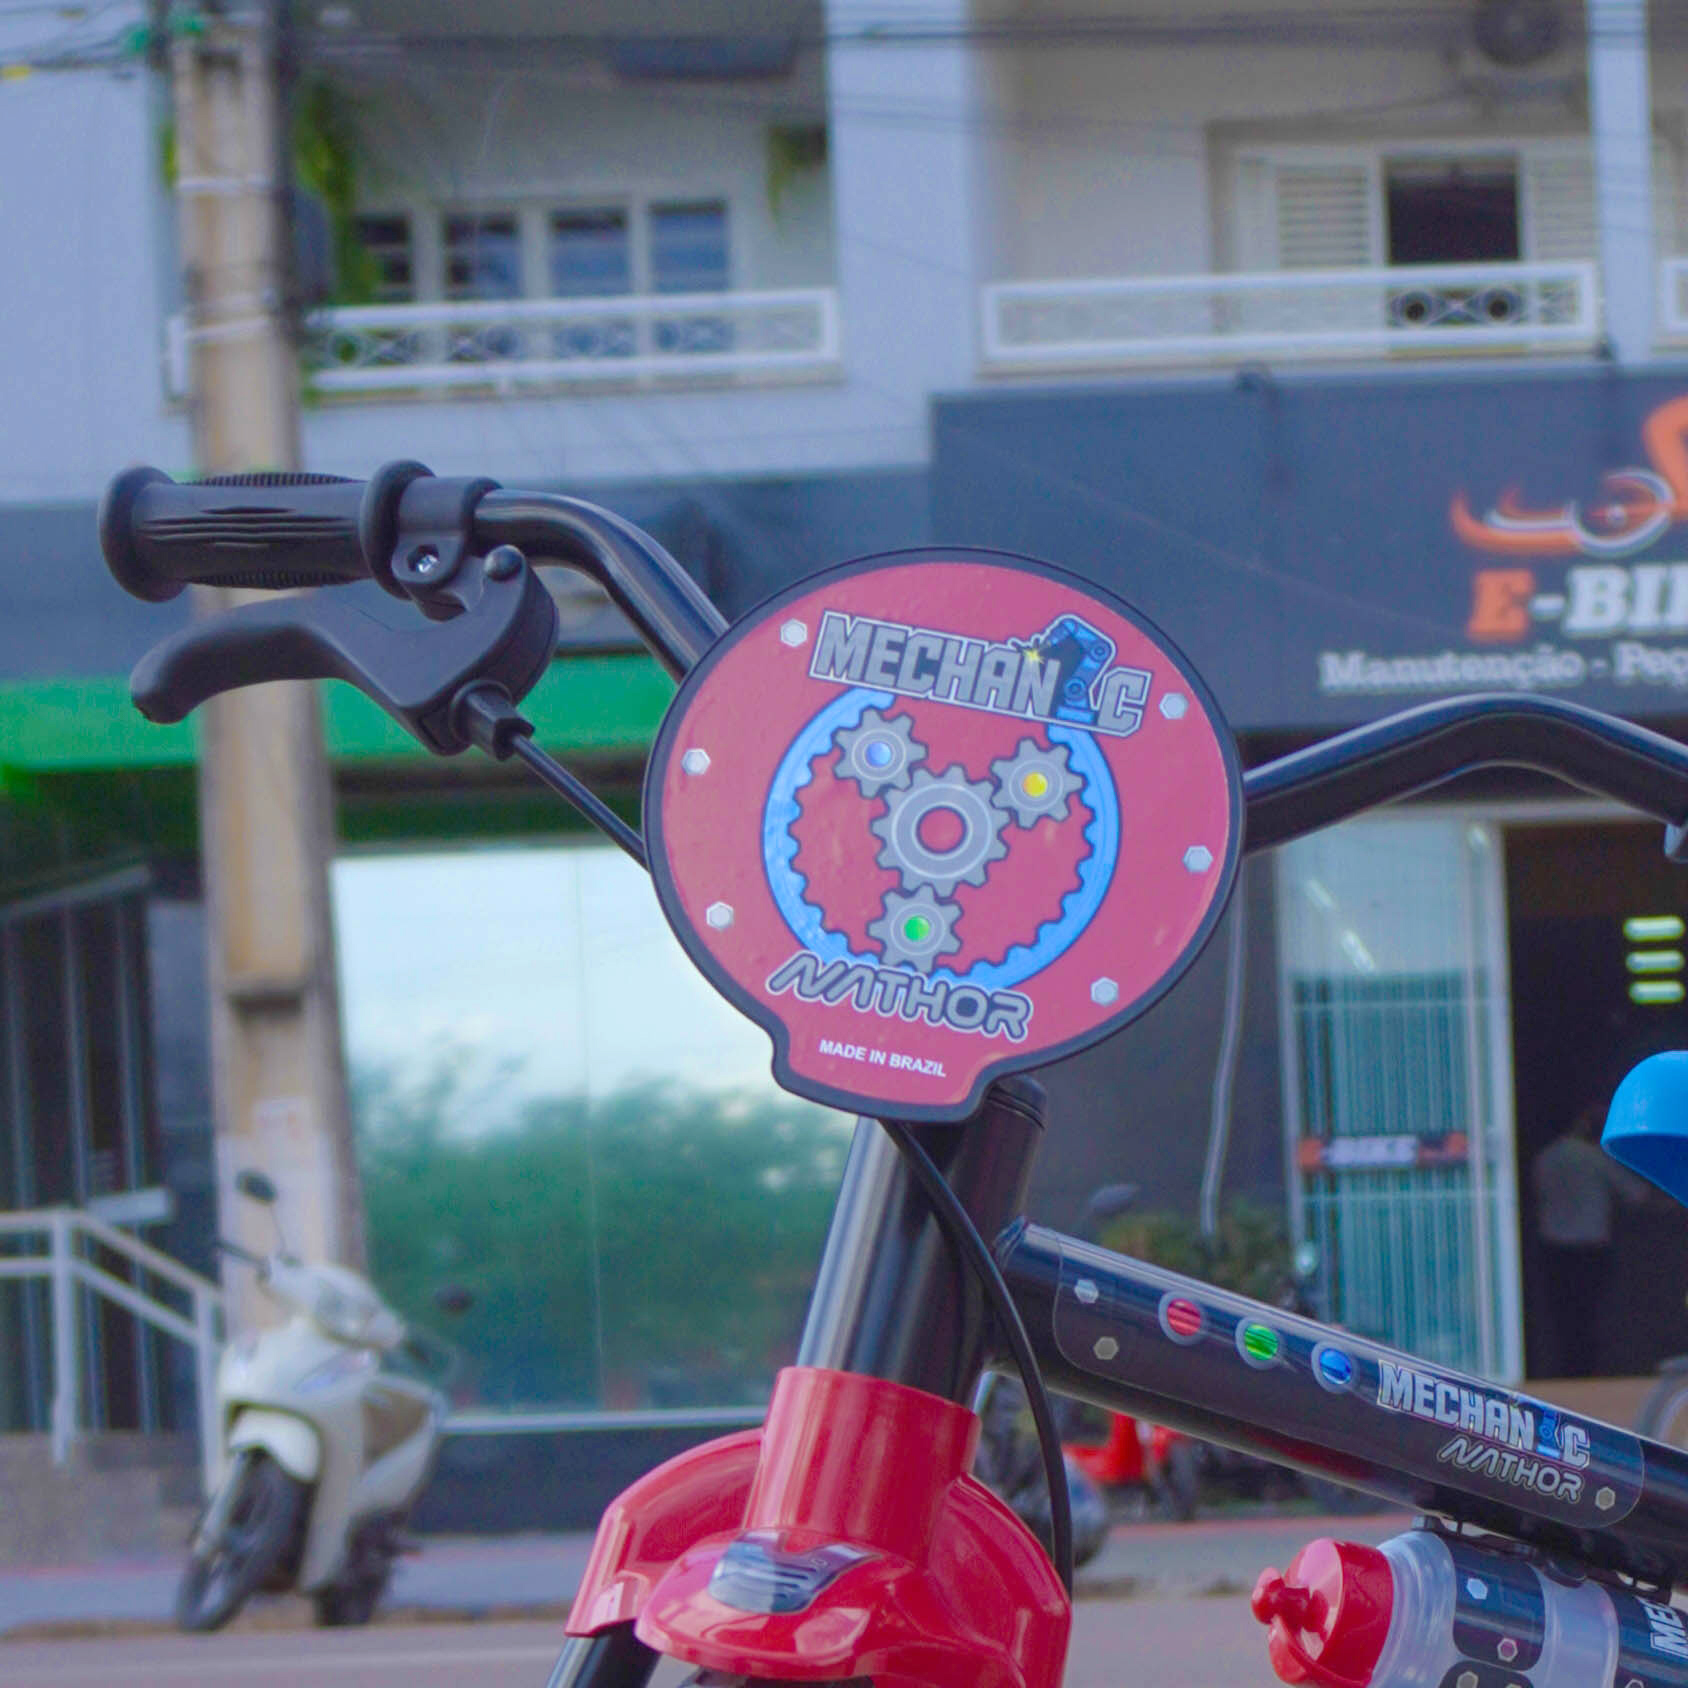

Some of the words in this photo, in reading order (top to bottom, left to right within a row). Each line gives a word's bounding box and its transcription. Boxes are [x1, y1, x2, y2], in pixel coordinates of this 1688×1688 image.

[1320, 644, 1585, 692] Manutenção
[766, 950, 1034, 1042] NATHOR
[819, 1039, 867, 1061] MADE
[869, 1049, 886, 1065] IN
[889, 1052, 946, 1078] BRAZIL
[1436, 1434, 1584, 1504] NATHOR
